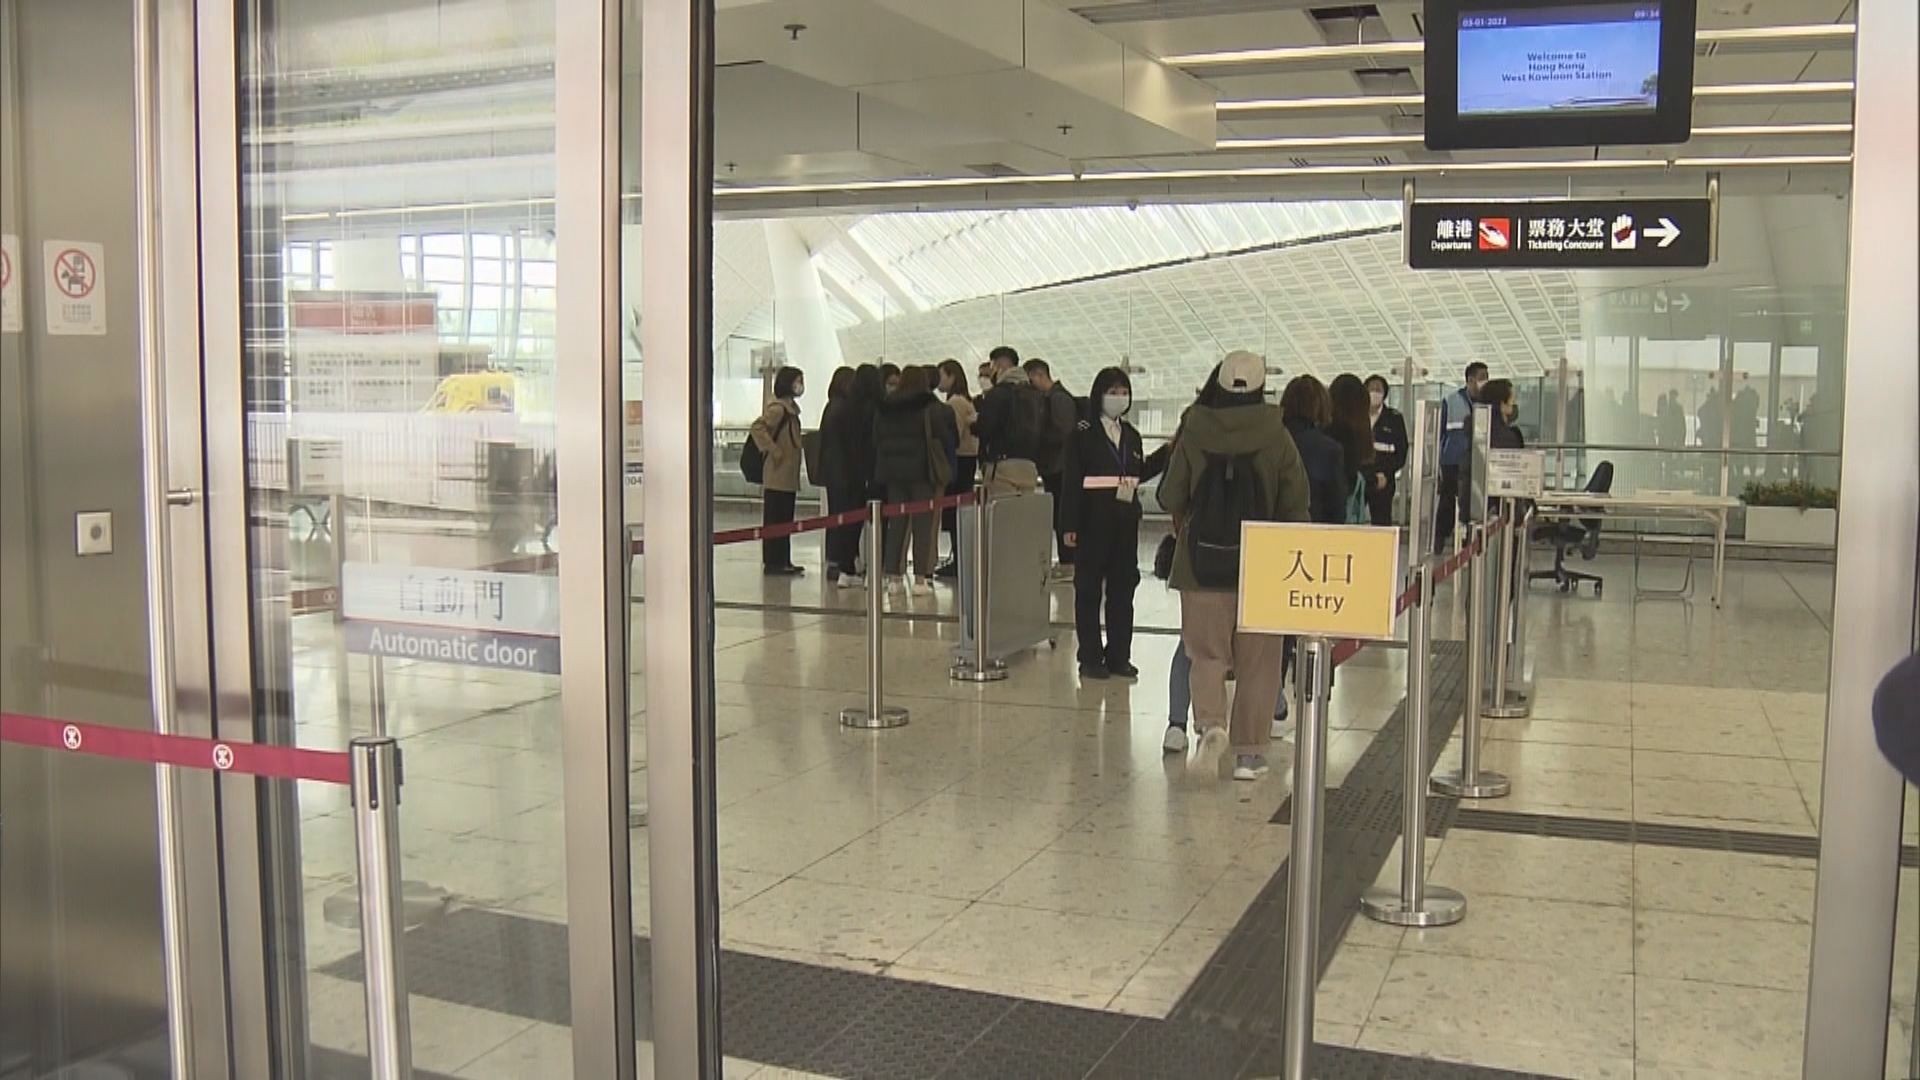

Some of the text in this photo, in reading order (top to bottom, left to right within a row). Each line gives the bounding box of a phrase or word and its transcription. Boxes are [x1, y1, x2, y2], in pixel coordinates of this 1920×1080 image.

[1527, 51, 1587, 61] Welcome to
[1501, 71, 1613, 82] West Kowloon Station
[1528, 62, 1586, 72] Hong Kong
[1436, 218, 1473, 239] 離港
[1528, 217, 1605, 238] 票務大堂
[1431, 240, 1472, 251] Departures
[1528, 239, 1604, 252] Ticketing Concourse
[1282, 549, 1353, 584] 入口
[400, 574, 504, 621] 自動門
[1289, 589, 1345, 614] Entry
[369, 627, 538, 667] Automatic door
